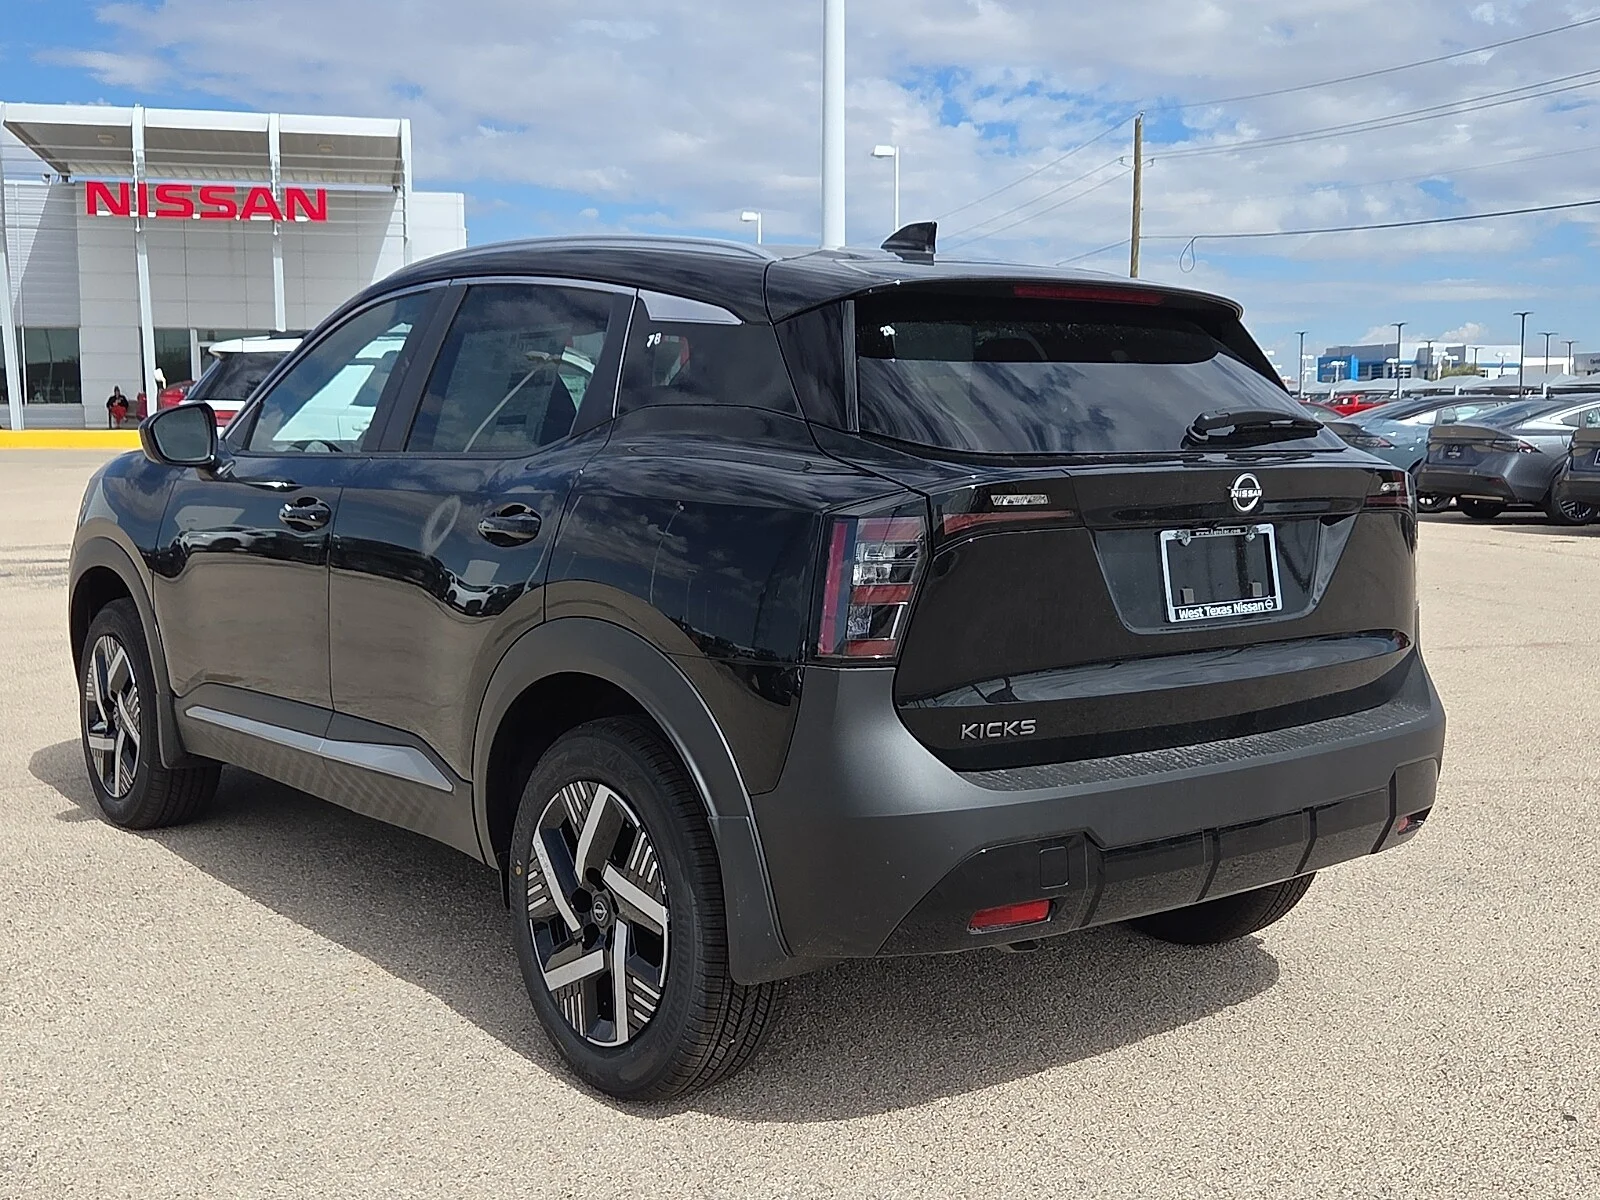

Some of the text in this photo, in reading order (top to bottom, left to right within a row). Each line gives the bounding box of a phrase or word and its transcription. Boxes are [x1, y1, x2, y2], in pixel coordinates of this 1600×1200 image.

[86, 181, 327, 222] NISSAN
[1230, 488, 1262, 499] NISSAN
[1178, 600, 1264, 620] West Texas Nissan
[961, 719, 1036, 740] KICKS
